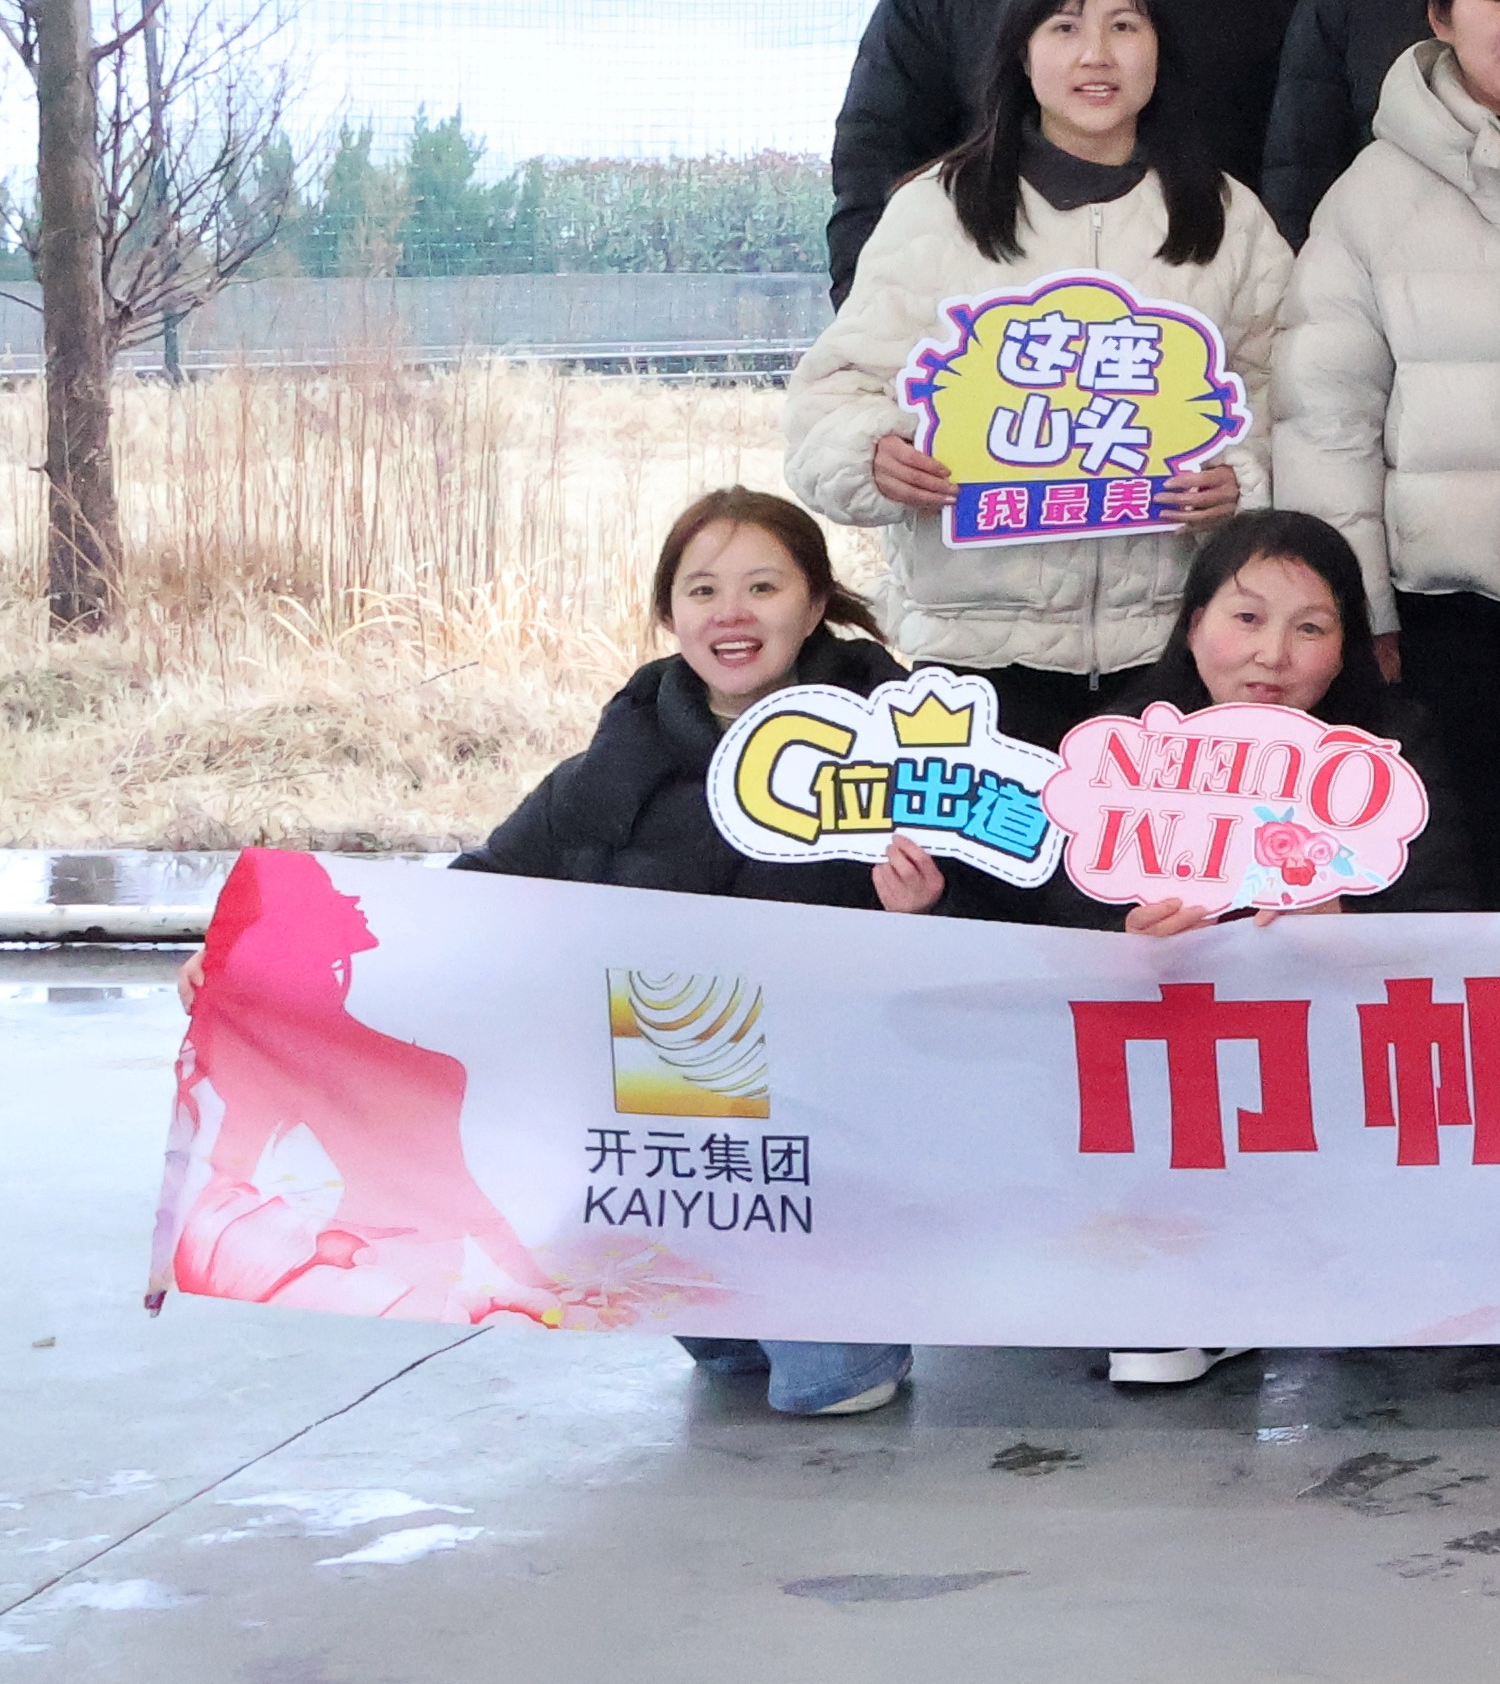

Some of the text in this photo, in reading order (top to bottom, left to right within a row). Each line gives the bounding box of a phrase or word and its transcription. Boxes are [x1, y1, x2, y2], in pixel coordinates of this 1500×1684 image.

[997, 310, 1164, 396] 这座
[986, 393, 1152, 477] 山头
[978, 479, 1154, 531] 我最美
[735, 709, 1051, 864] C位出道
[1088, 725, 1401, 832] QUEEN
[585, 1128, 811, 1186] 开元集团
[583, 1185, 813, 1234] KAIYUAN
